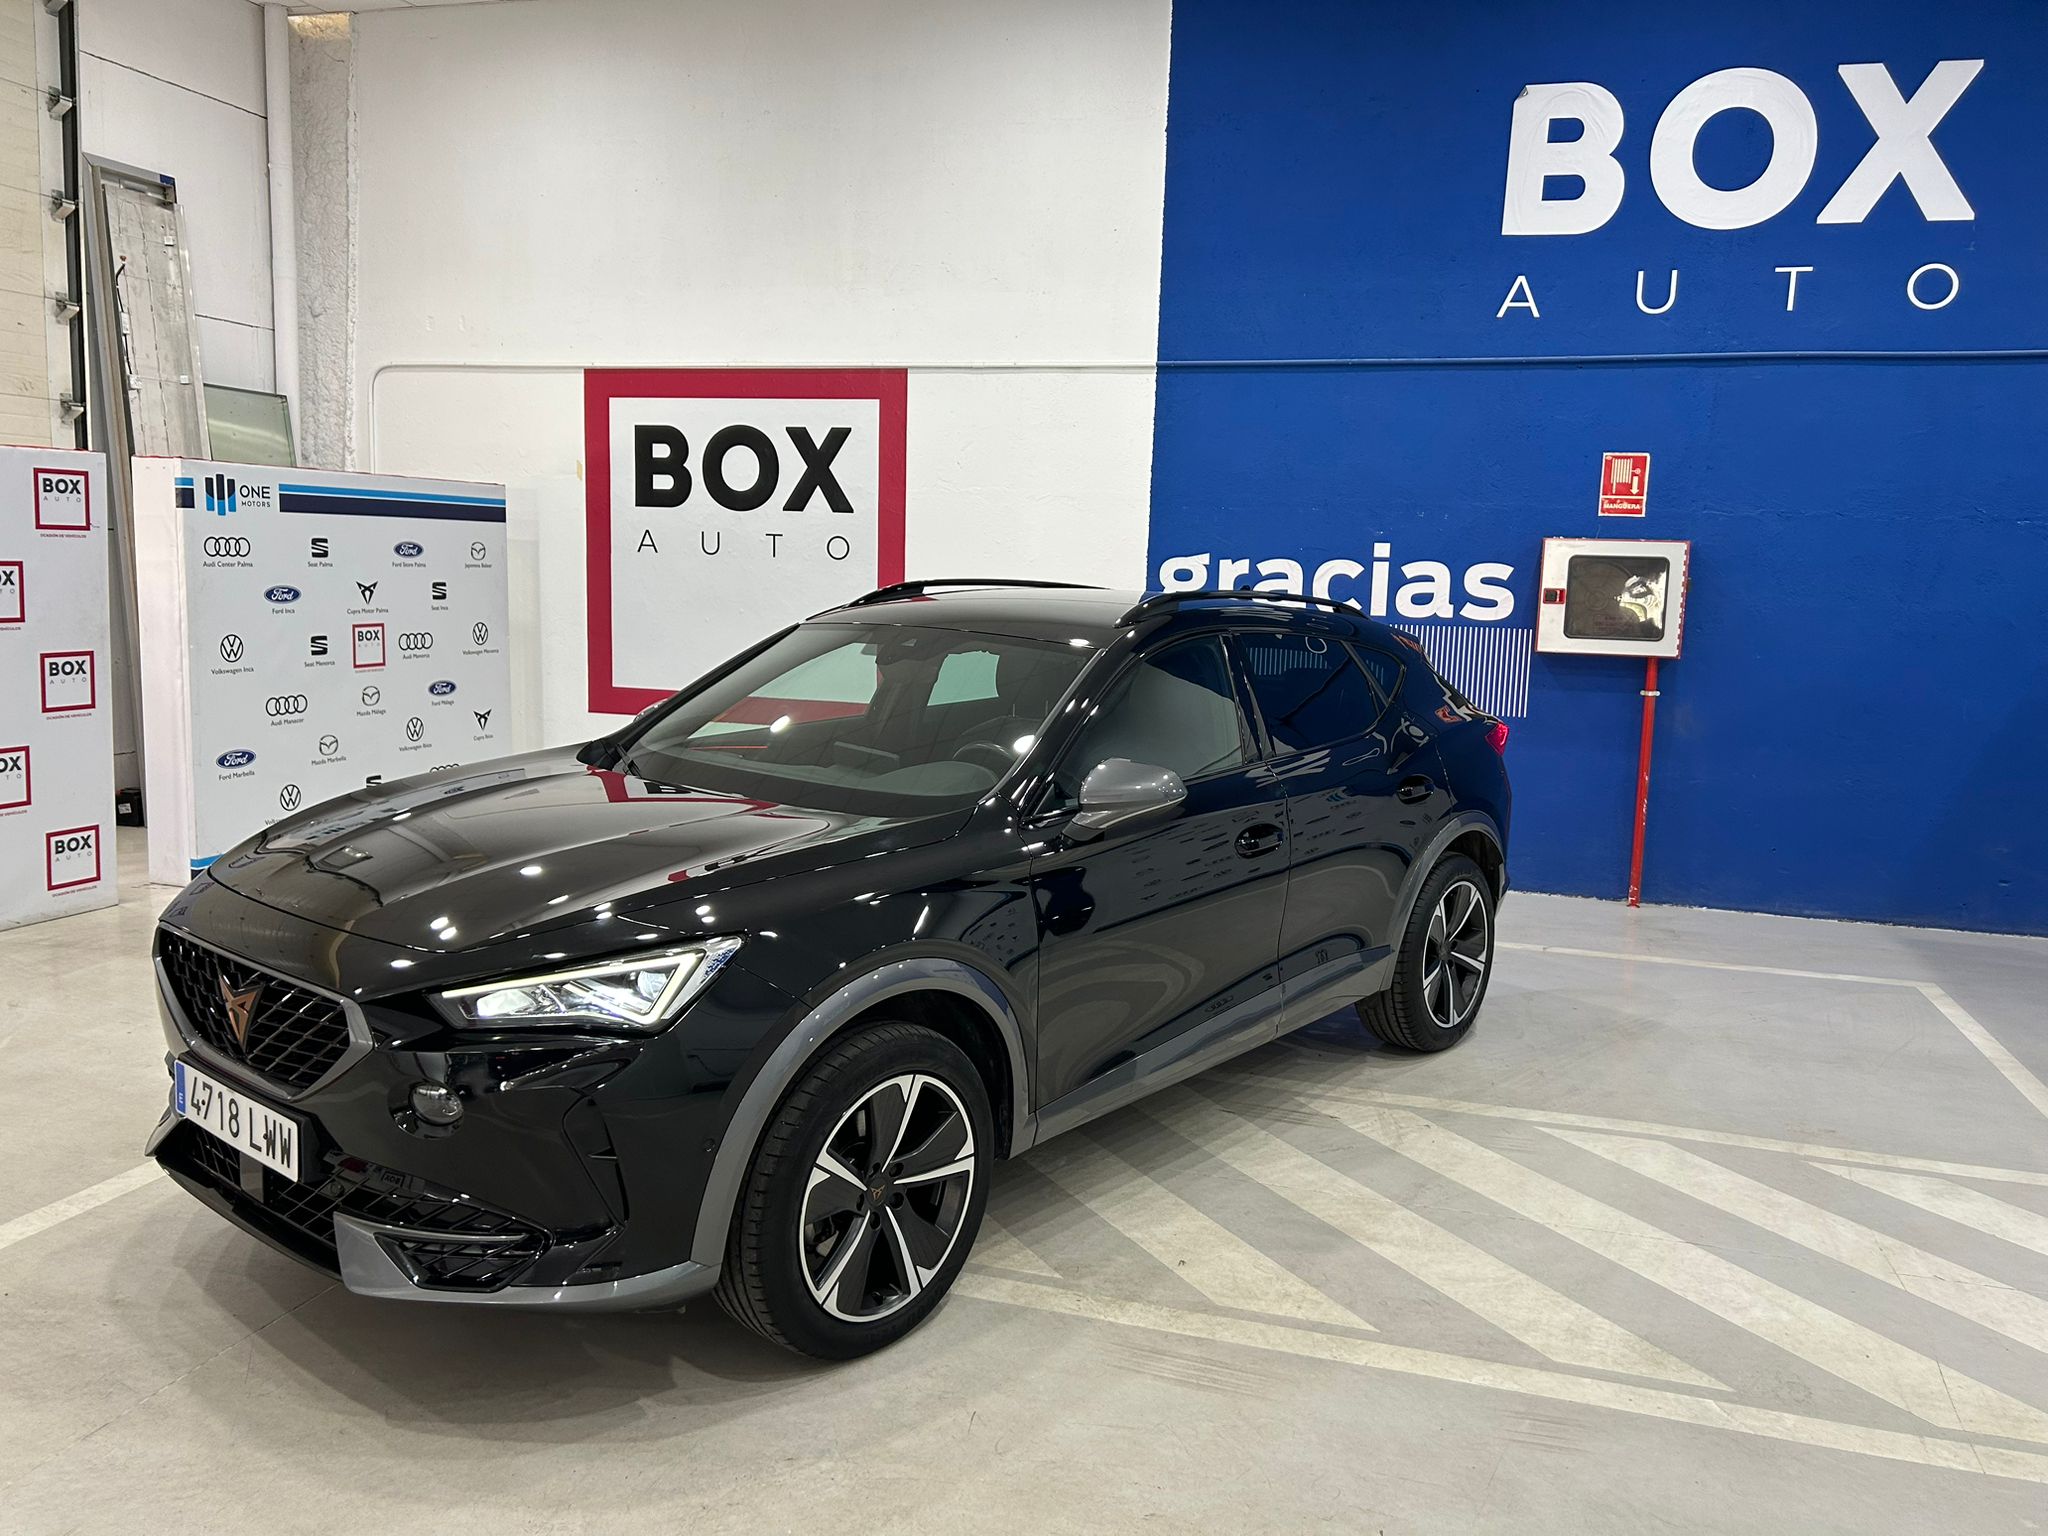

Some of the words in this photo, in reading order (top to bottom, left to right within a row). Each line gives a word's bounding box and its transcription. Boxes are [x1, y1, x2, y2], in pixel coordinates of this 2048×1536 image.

[1501, 59, 1984, 235] BOX
[1497, 263, 1959, 318] AUTO
[634, 424, 854, 513] BOX
[42, 478, 81, 495] BOX
[239, 485, 271, 499] ONE
[399, 544, 419, 555] Ford
[637, 529, 850, 560] AUTO
[271, 588, 295, 600] Ford
[357, 630, 380, 641] BOX
[49, 660, 87, 676] BOX
[224, 752, 249, 766] Ford
[218, 773, 232, 781] Ford
[232, 770, 255, 778] Marbella
[55, 834, 92, 854] BOX
[55, 851, 92, 862] AUTO
[190, 1077, 240, 1138] 4718
[249, 1107, 291, 1169] LWW
